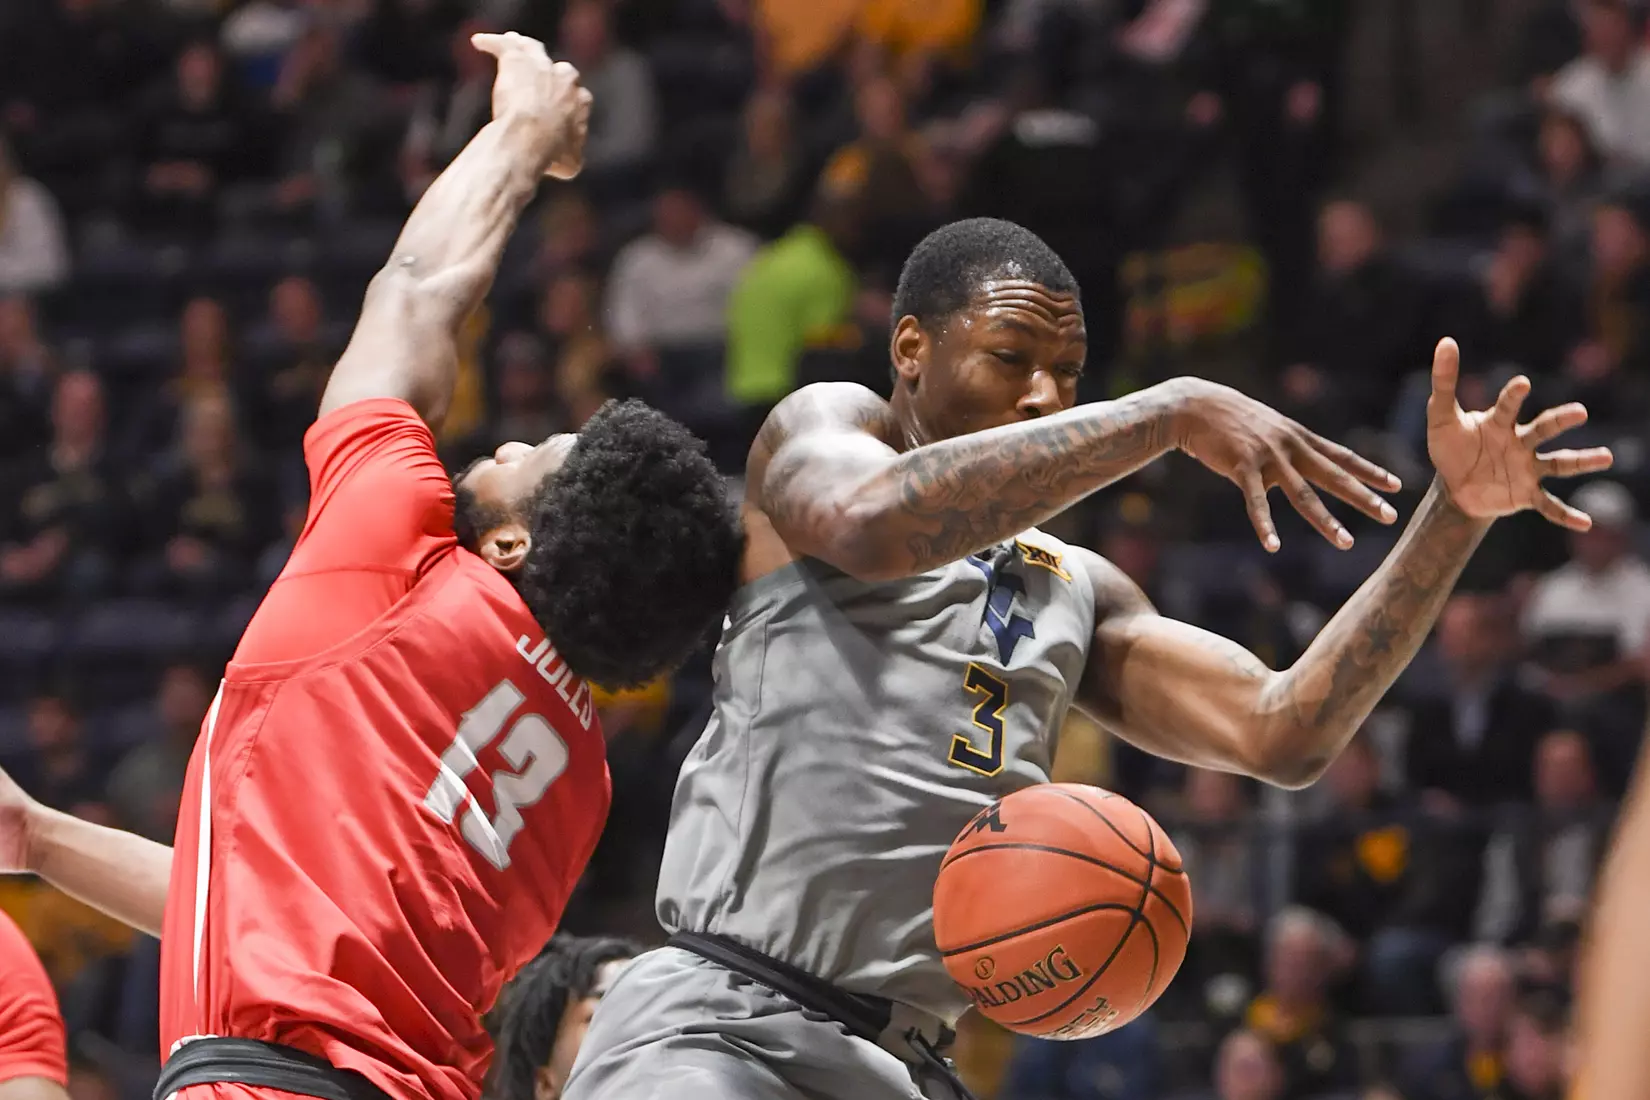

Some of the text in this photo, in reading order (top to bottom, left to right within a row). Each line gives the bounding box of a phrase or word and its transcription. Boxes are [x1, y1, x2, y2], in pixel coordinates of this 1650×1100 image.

[423, 677, 570, 873] 13
[948, 661, 1008, 777] 3
[955, 944, 1083, 1009] PALDING
